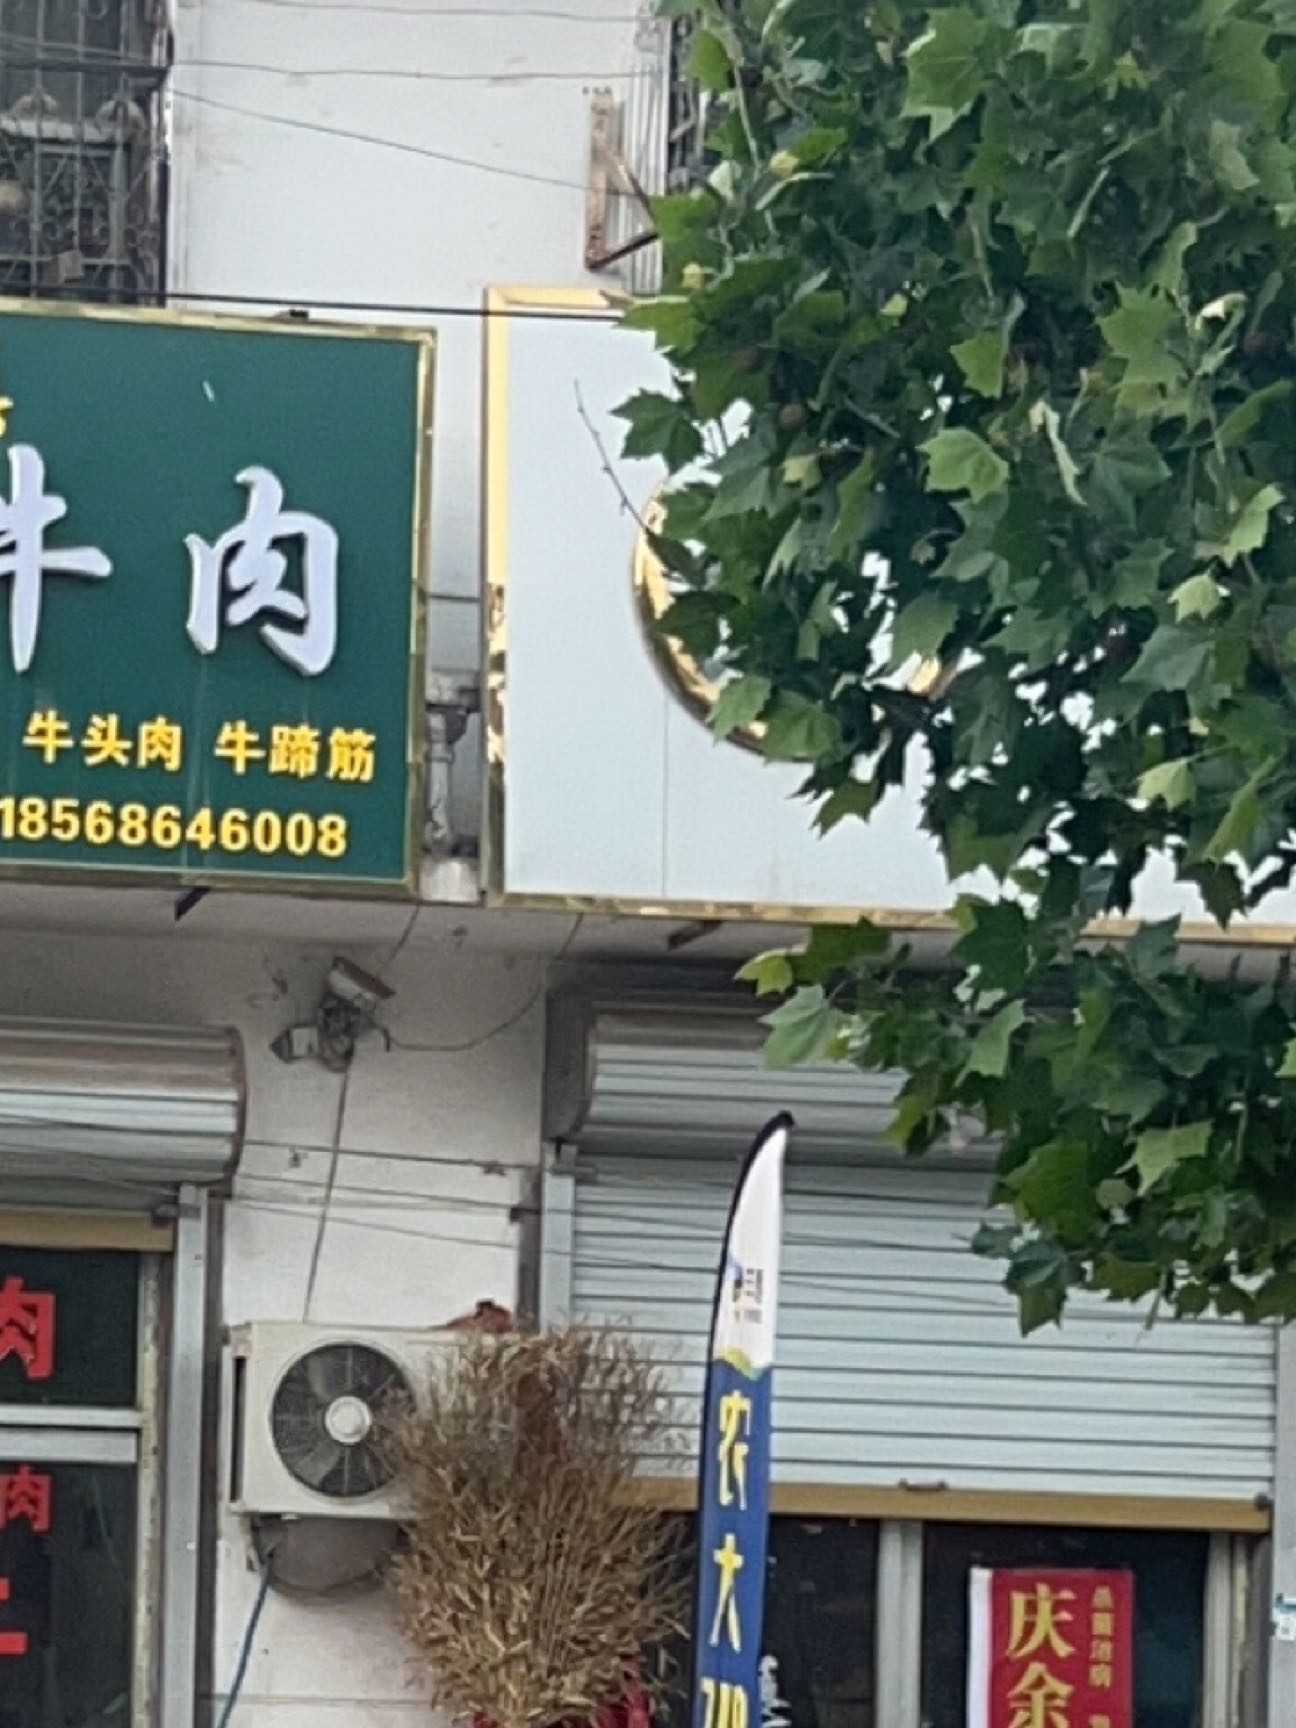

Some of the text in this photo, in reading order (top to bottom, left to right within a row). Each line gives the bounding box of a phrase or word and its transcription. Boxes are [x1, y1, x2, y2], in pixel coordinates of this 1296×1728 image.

[22, 710, 182, 771] 牛头肉
[214, 720, 376, 782] 牛蹄筋
